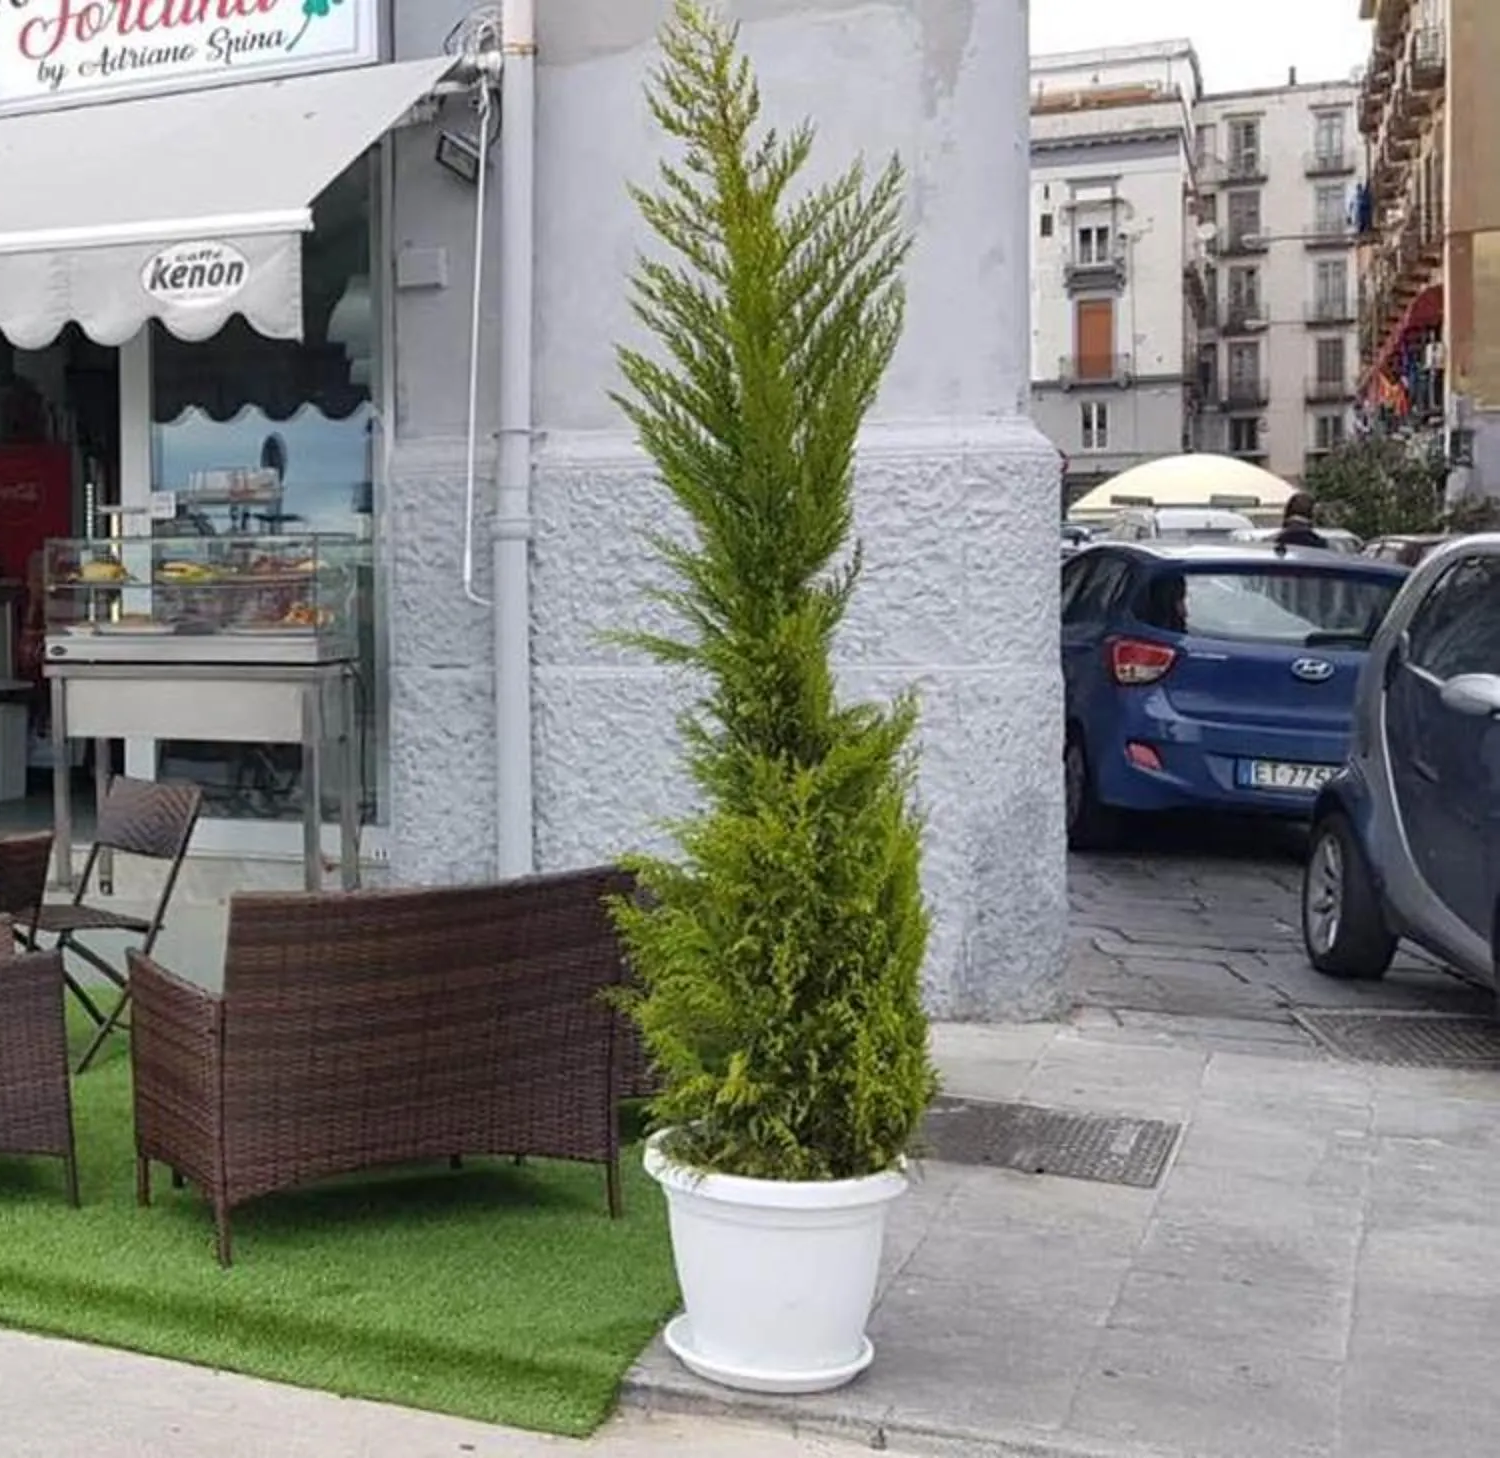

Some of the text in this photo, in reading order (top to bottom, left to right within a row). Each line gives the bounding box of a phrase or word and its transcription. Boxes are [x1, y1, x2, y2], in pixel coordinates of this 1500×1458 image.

[36, 26, 288, 90] by Adriano Spina
[149, 258, 244, 290] kenon
